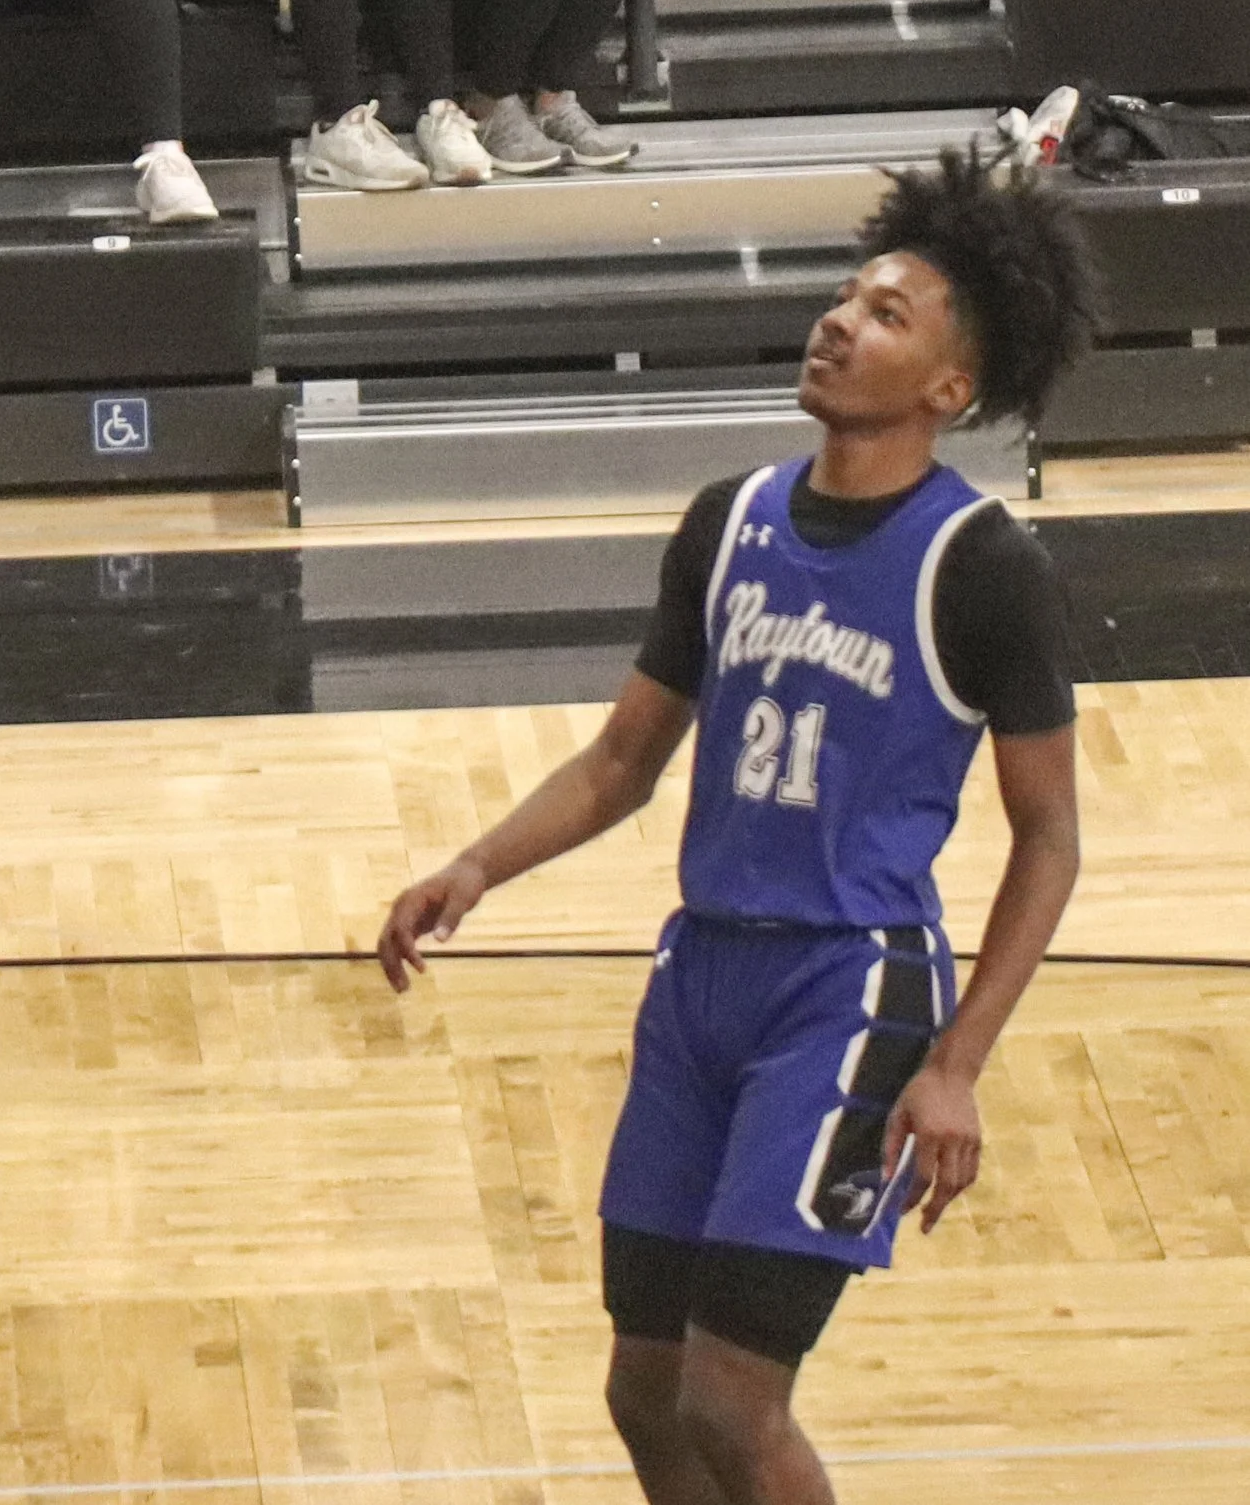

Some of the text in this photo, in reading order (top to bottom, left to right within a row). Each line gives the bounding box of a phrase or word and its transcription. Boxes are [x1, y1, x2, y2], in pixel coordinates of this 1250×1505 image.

[1174, 188, 1190, 201] 10
[718, 580, 895, 698] Raytown
[733, 695, 827, 808] 21
